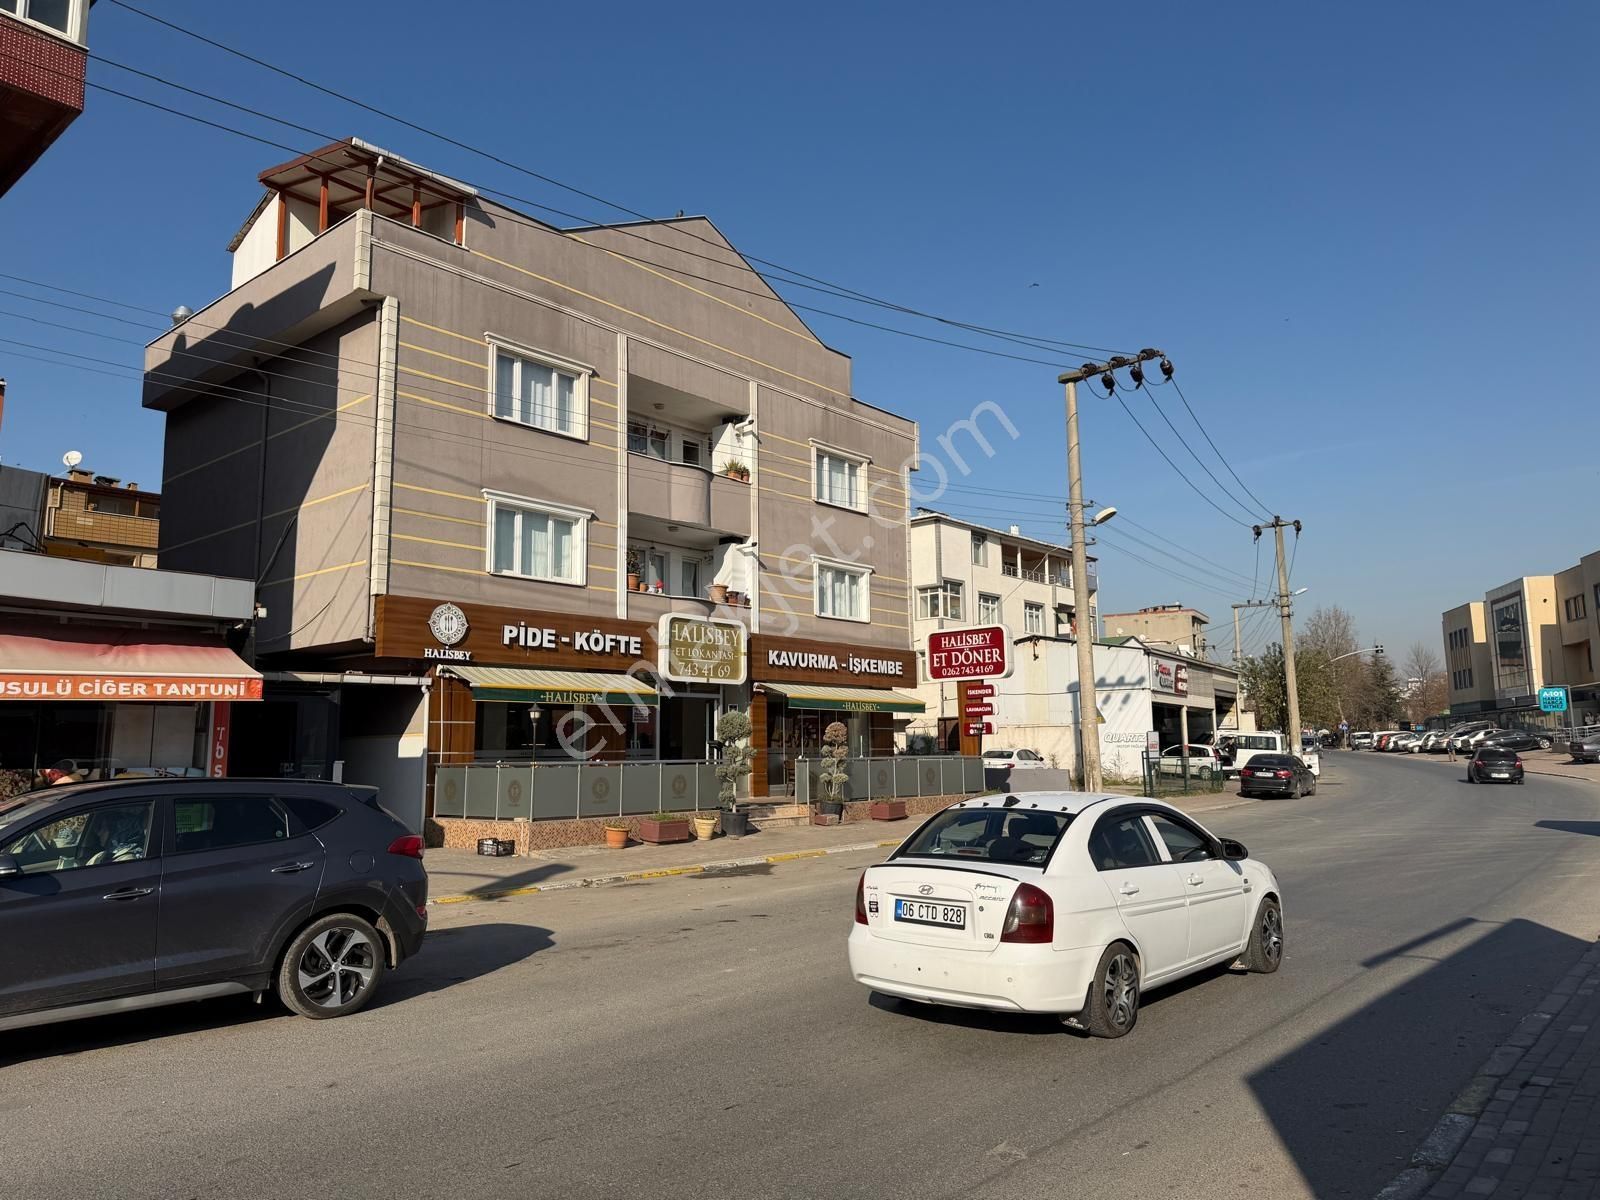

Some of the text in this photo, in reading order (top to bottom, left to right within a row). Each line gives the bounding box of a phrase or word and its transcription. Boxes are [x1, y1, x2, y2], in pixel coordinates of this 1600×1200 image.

[502, 621, 556, 648] PİDE
[574, 629, 642, 655] KÖFTE
[671, 623, 740, 647] HALİSBEY
[941, 632, 992, 648] HALİSBEY
[424, 646, 472, 661] HALİSBEY
[688, 648, 734, 661] LOKANTASI
[768, 649, 838, 670] KAVURMA
[849, 653, 903, 675] İŞKEMBE
[932, 647, 1003, 667] ET DÖNER
[678, 661, 731, 678] 743 41 69
[941, 667, 960, 676] 0262
[961, 666, 975, 675] 743
[78, 679, 147, 696] CİĞER
[153, 681, 245, 696] TANTUNİ
[545, 690, 599, 704] HALİSBEY
[845, 701, 878, 711] HALİSBEY
[902, 902, 962, 924] 06 CTD 828
